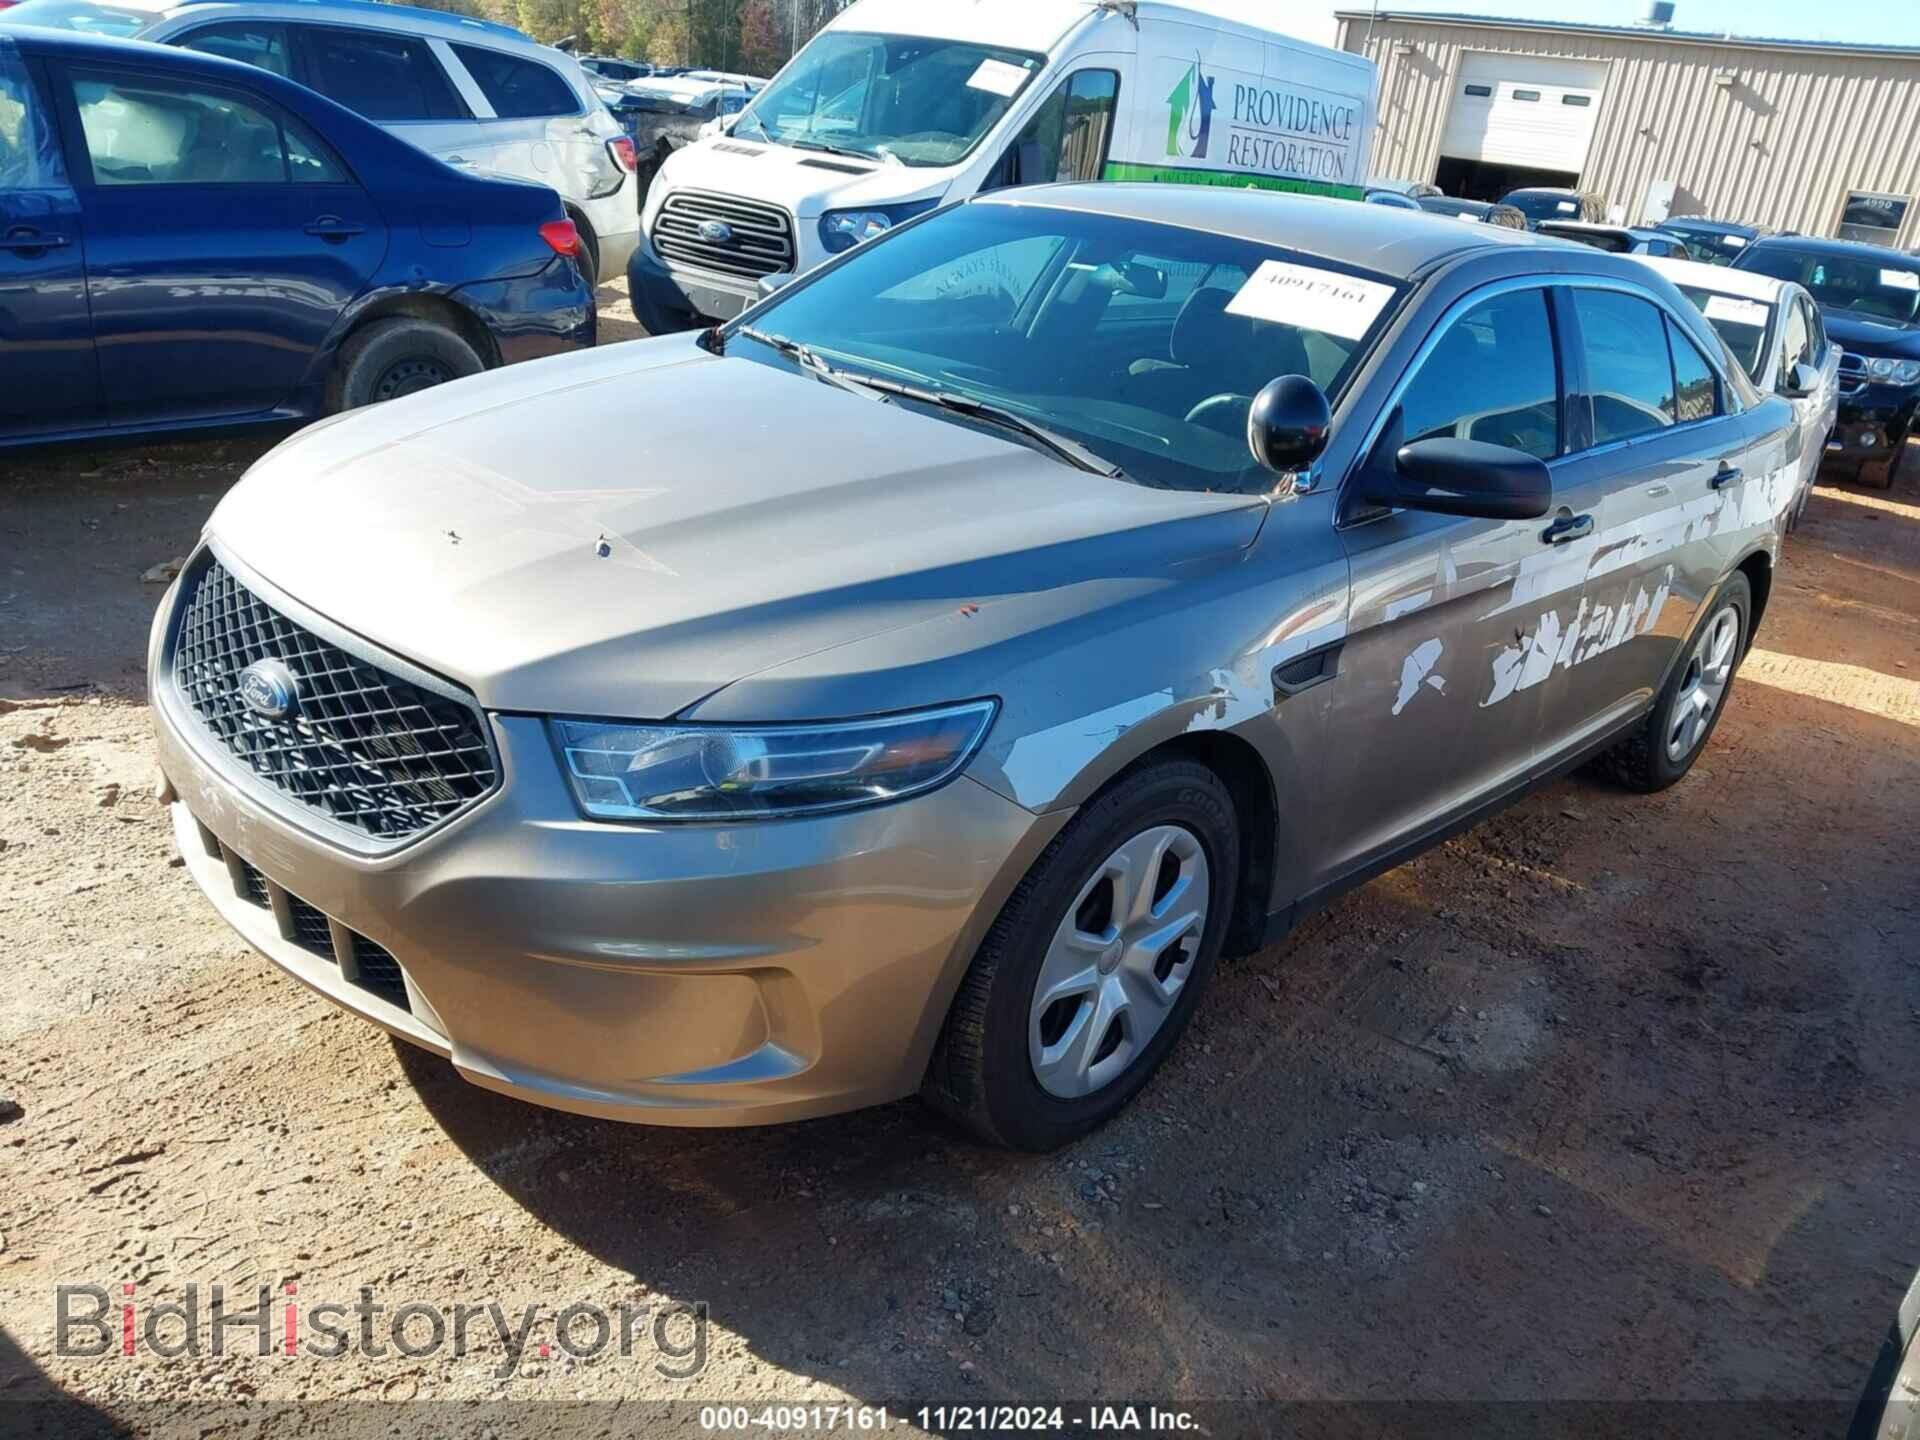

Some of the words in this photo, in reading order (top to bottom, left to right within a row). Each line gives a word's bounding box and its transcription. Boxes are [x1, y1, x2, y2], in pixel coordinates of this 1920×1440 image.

[1232, 83, 1354, 141] PROVIDENCE
[1227, 134, 1348, 179] RESTORATION
[1265, 273, 1366, 303] 40917161
